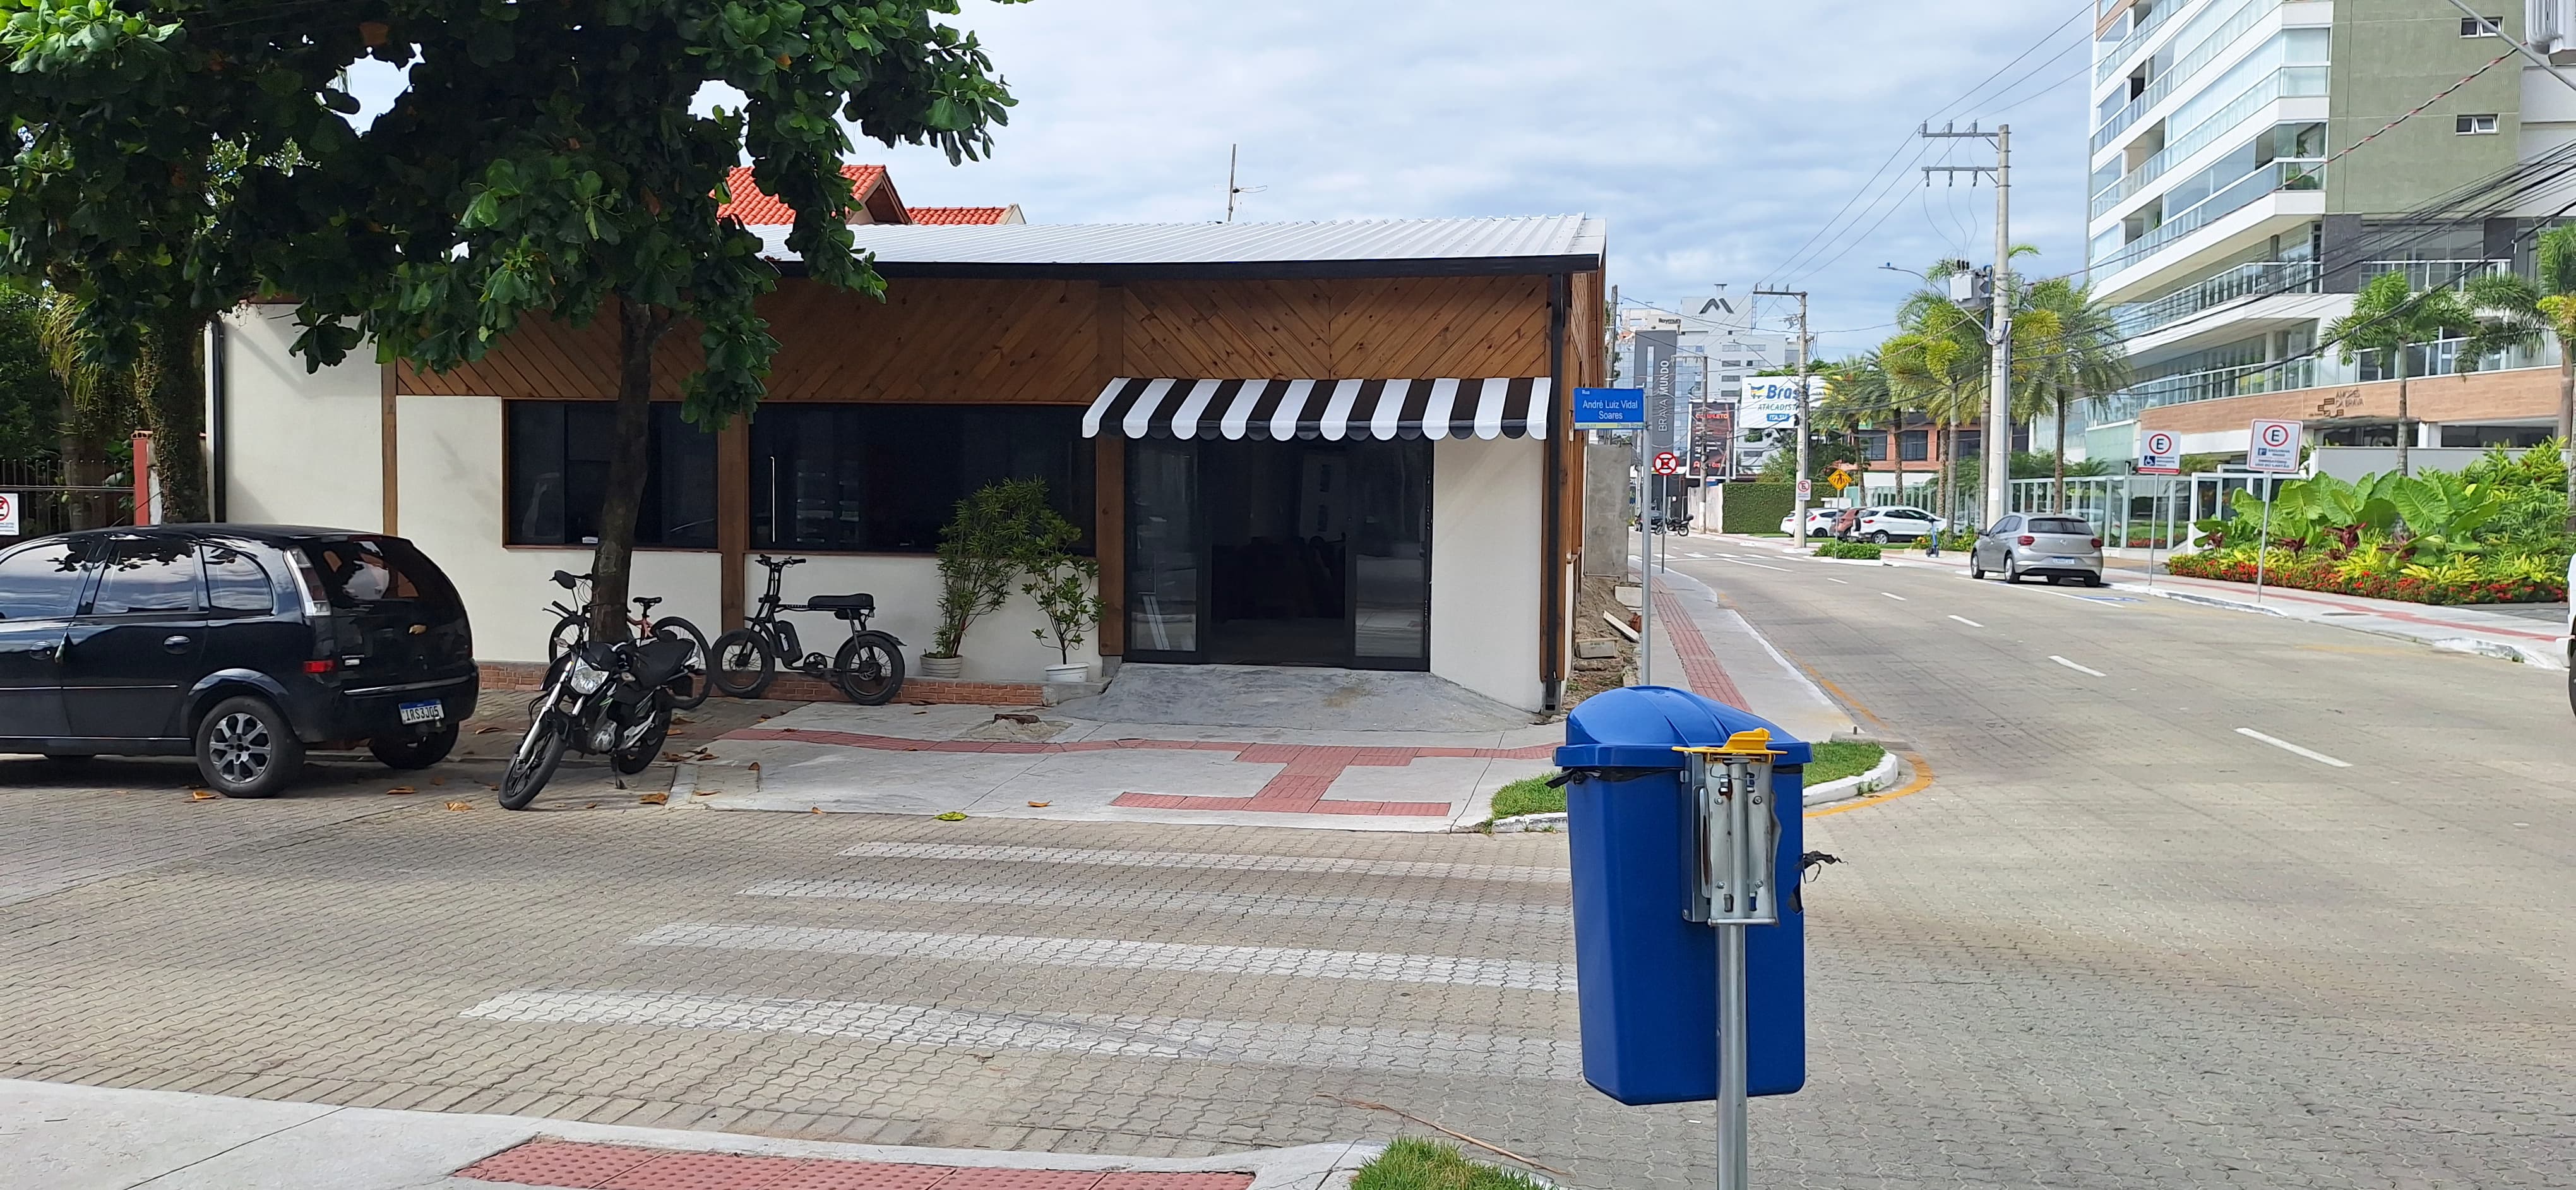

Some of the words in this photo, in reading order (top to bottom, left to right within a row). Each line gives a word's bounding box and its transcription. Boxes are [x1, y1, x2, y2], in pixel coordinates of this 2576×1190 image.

[1659, 360, 1670, 395] MUNDO
[1582, 399, 1604, 409] André
[1605, 399, 1619, 409] Luiz
[1620, 399, 1638, 409] Vidal
[1599, 410, 1623, 419] Soares
[1659, 399, 1668, 431] BRAVA
[2271, 430, 2280, 442] E
[2156, 438, 2164, 450] E
